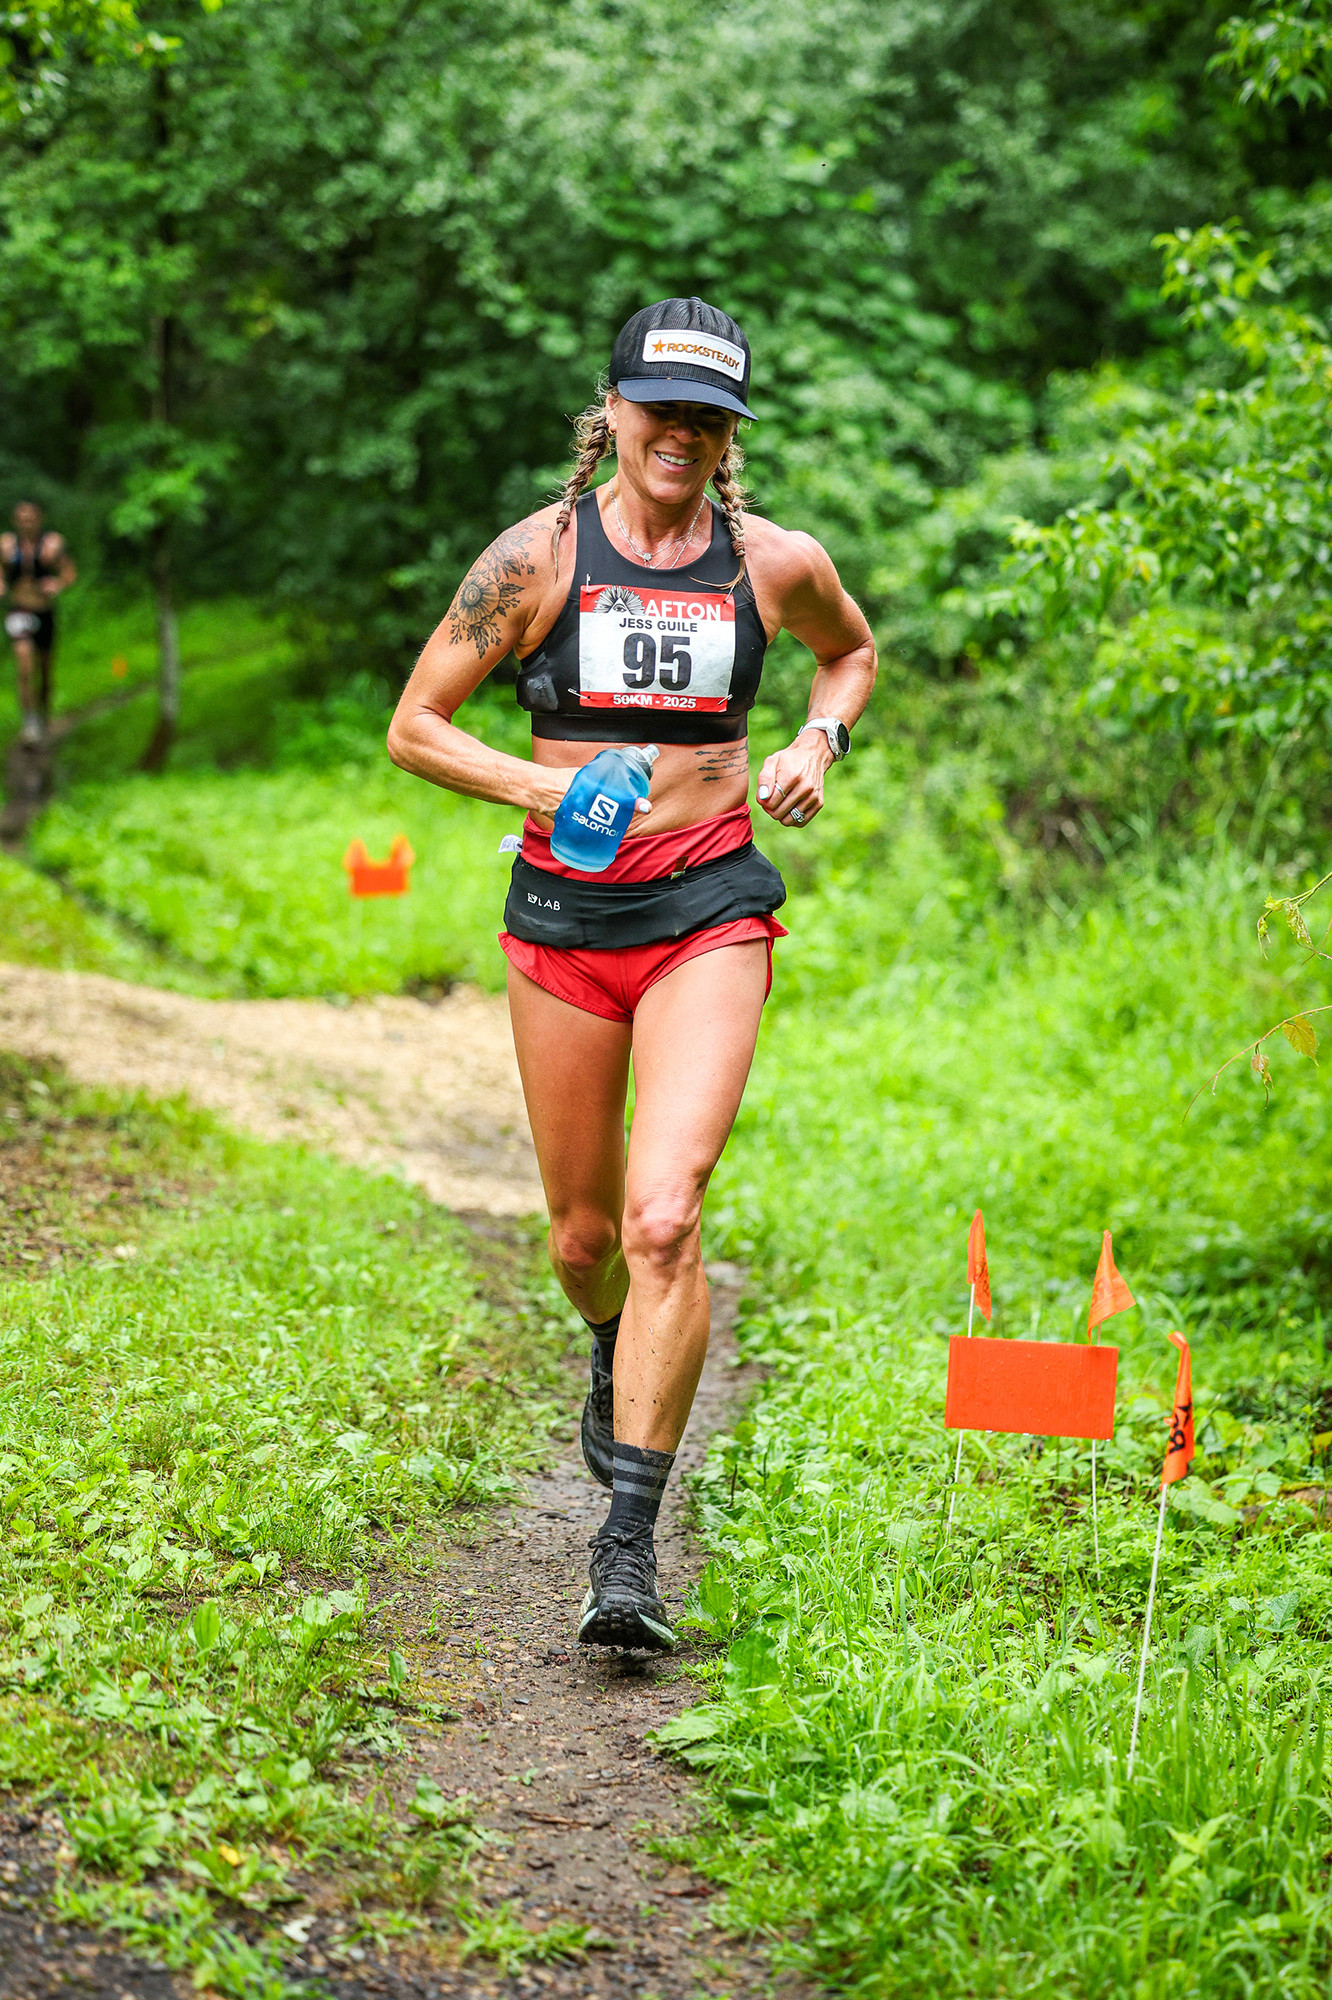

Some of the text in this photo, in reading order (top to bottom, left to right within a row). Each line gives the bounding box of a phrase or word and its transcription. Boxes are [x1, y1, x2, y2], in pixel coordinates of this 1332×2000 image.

[667, 343, 740, 370] ROCKSTEADY
[645, 599, 720, 621] AFTON
[619, 618, 698, 632] JESS GUILE
[622, 632, 692, 691] 95
[613, 694, 652, 706] 50KM
[662, 696, 697, 709] 2025
